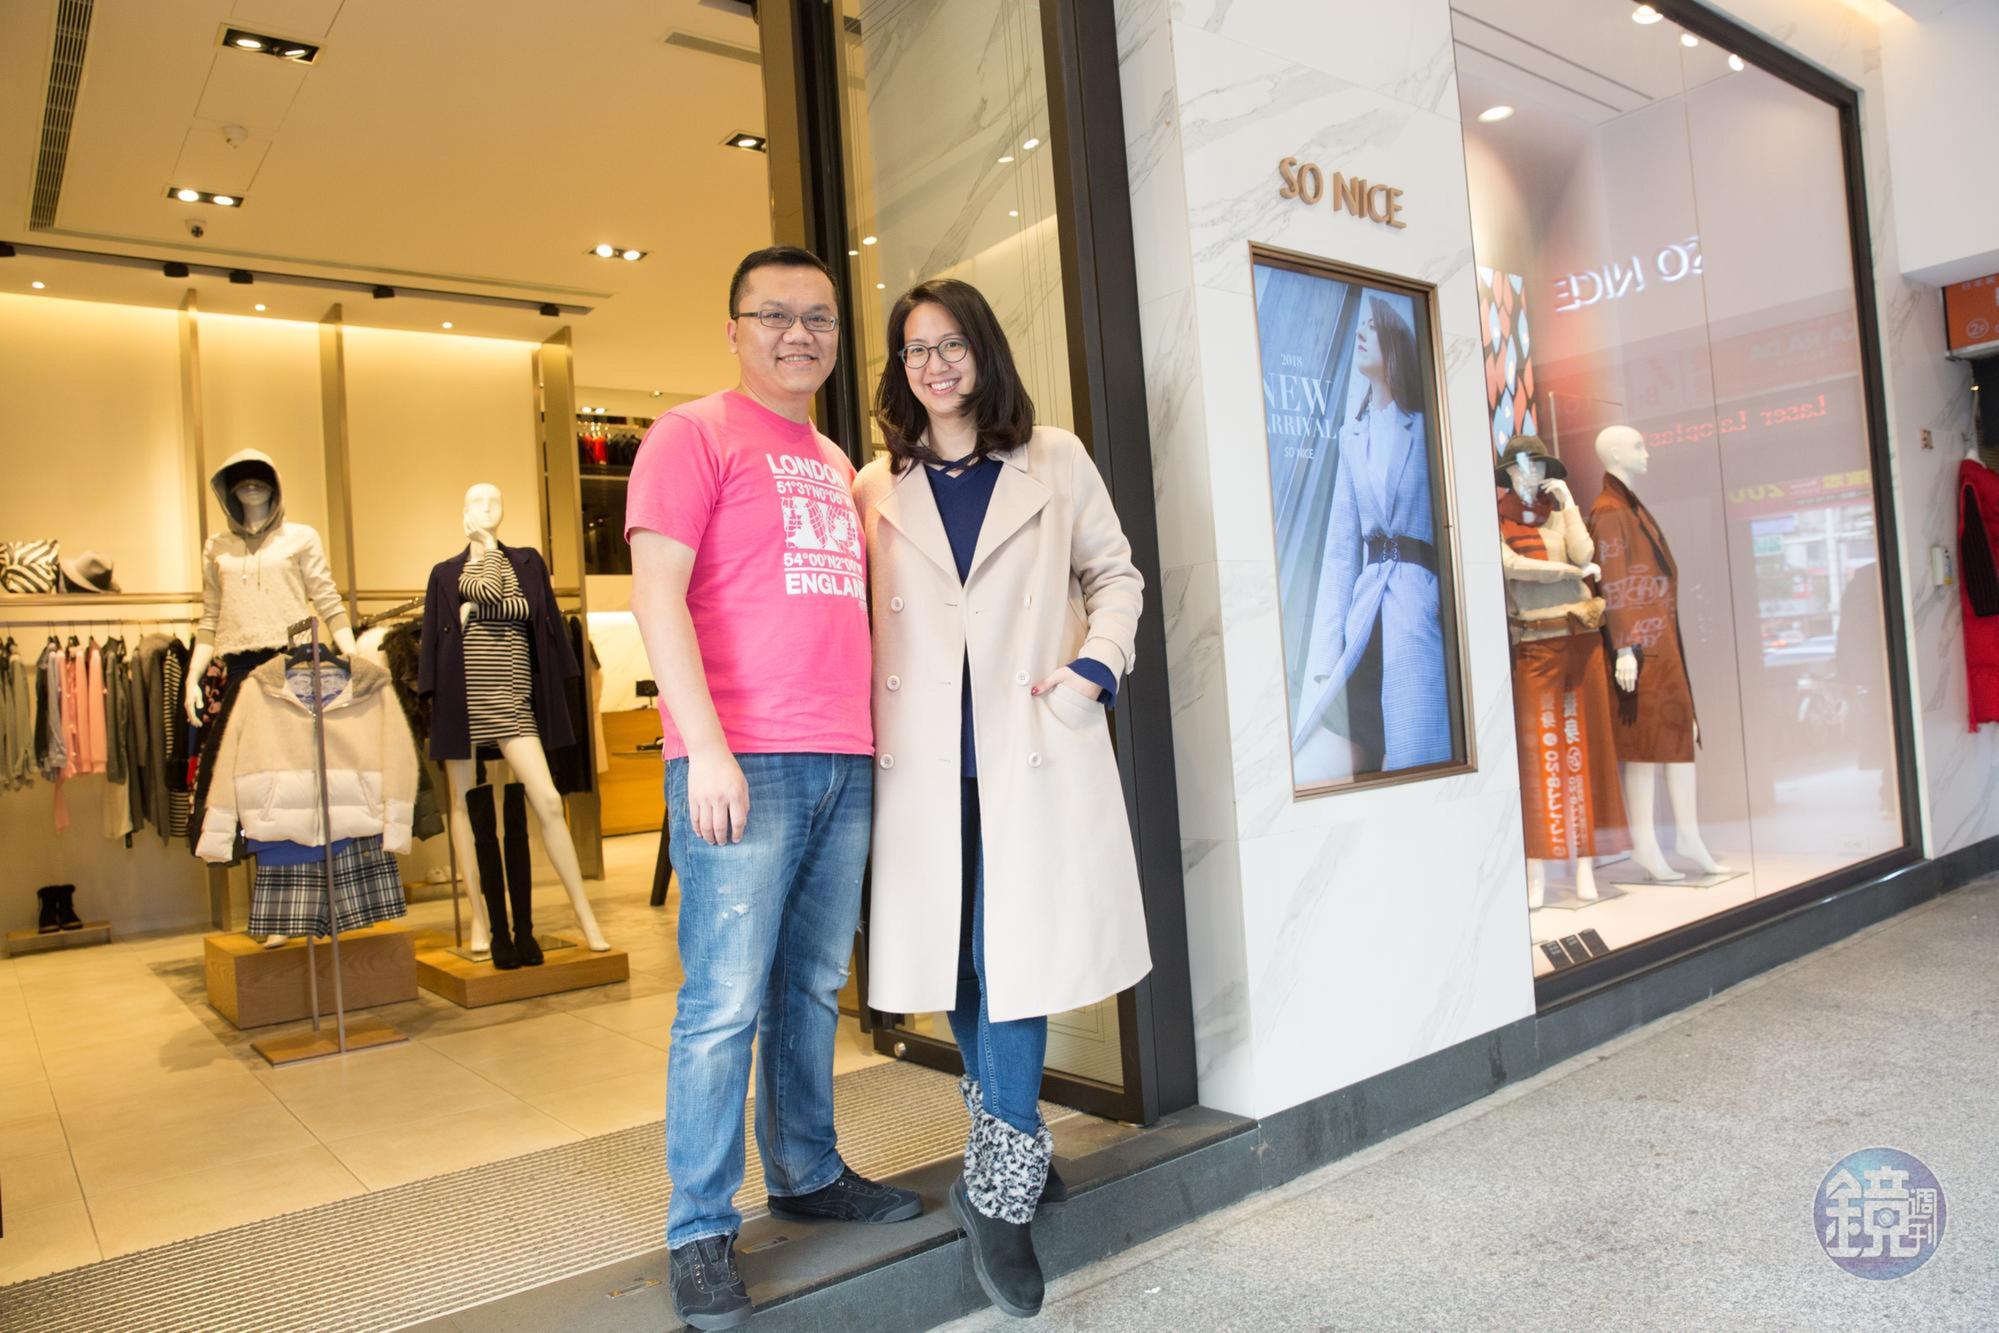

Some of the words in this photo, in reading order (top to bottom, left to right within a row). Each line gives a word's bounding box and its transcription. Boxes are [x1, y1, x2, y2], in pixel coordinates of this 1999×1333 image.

[1279, 156, 1324, 205] SO
[1333, 171, 1407, 230] NICE
[1281, 353, 1303, 368] 2018
[1263, 372, 1333, 416] NEW
[1267, 413, 1337, 440] RRIVAL
[1284, 447, 1296, 458] SO
[766, 453, 849, 490] LONDON
